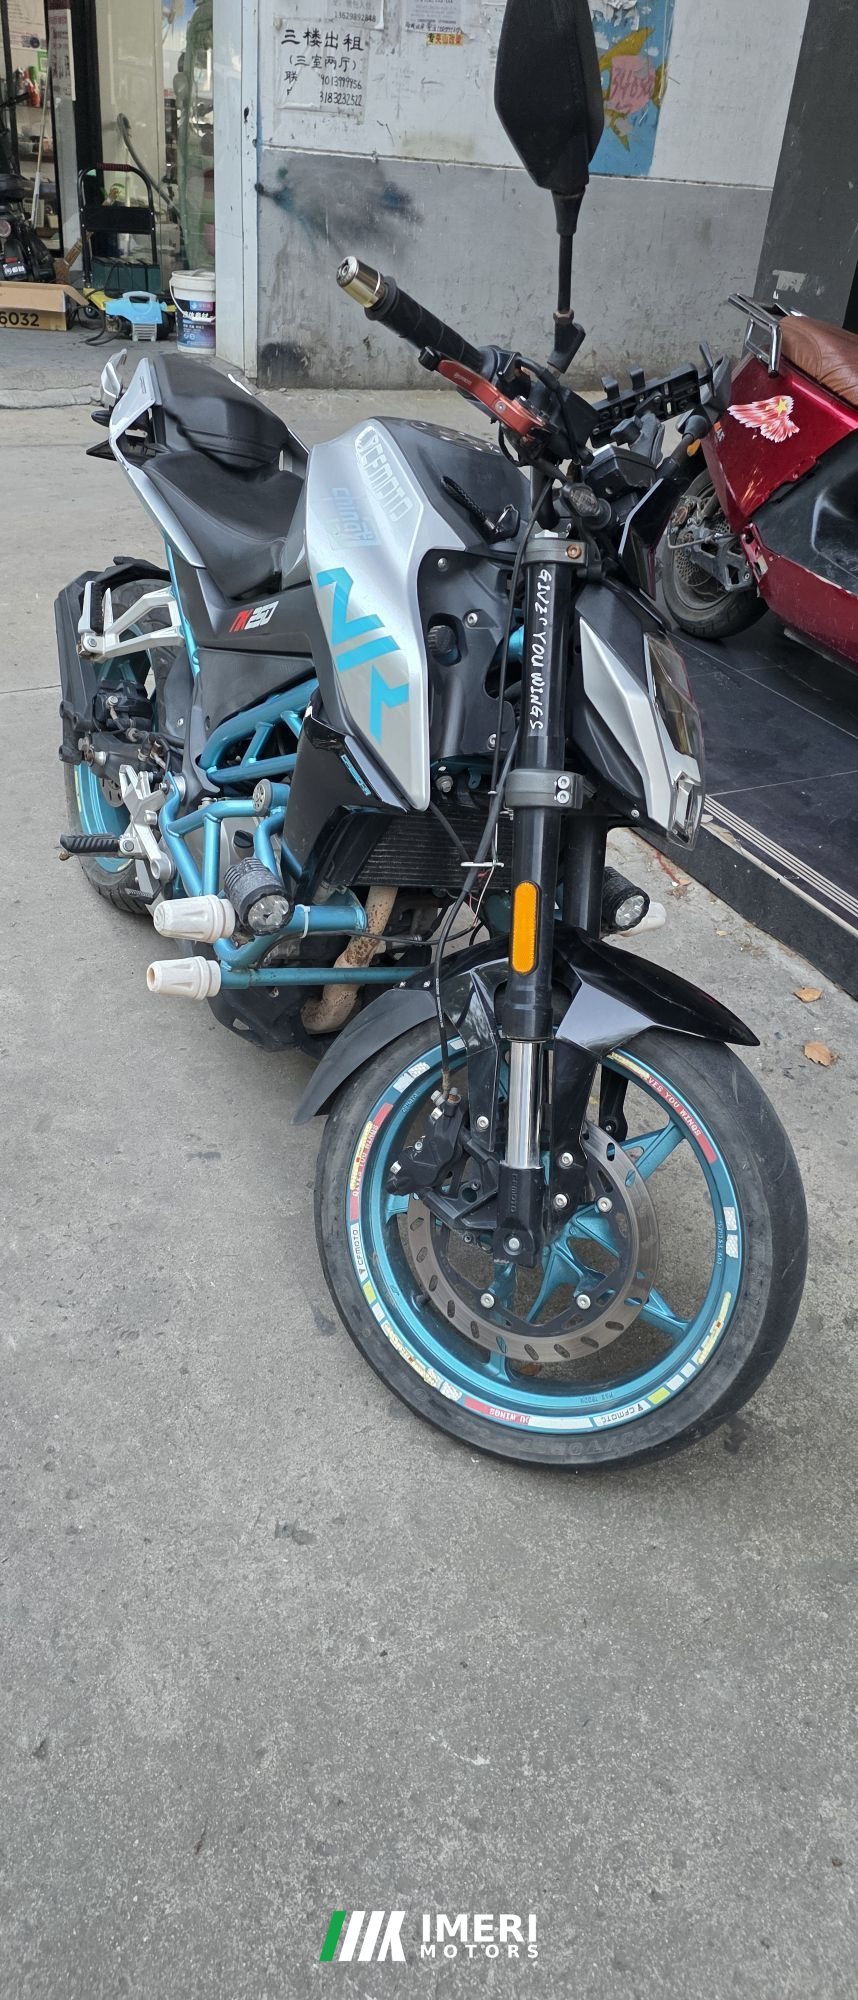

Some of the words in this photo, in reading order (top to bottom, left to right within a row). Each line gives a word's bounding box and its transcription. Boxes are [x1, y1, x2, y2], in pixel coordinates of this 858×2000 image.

[281, 27, 365, 52] 三楼出租
[0, 311, 40, 327] 6032
[530, 631, 548, 668] YOU
[529, 672, 546, 730] WINGS
[664, 1092, 680, 1108] YOU
[679, 1109, 702, 1137] WINGS
[352, 1229, 365, 1266] CFMOTO
[489, 1407, 516, 1422] WINGS
